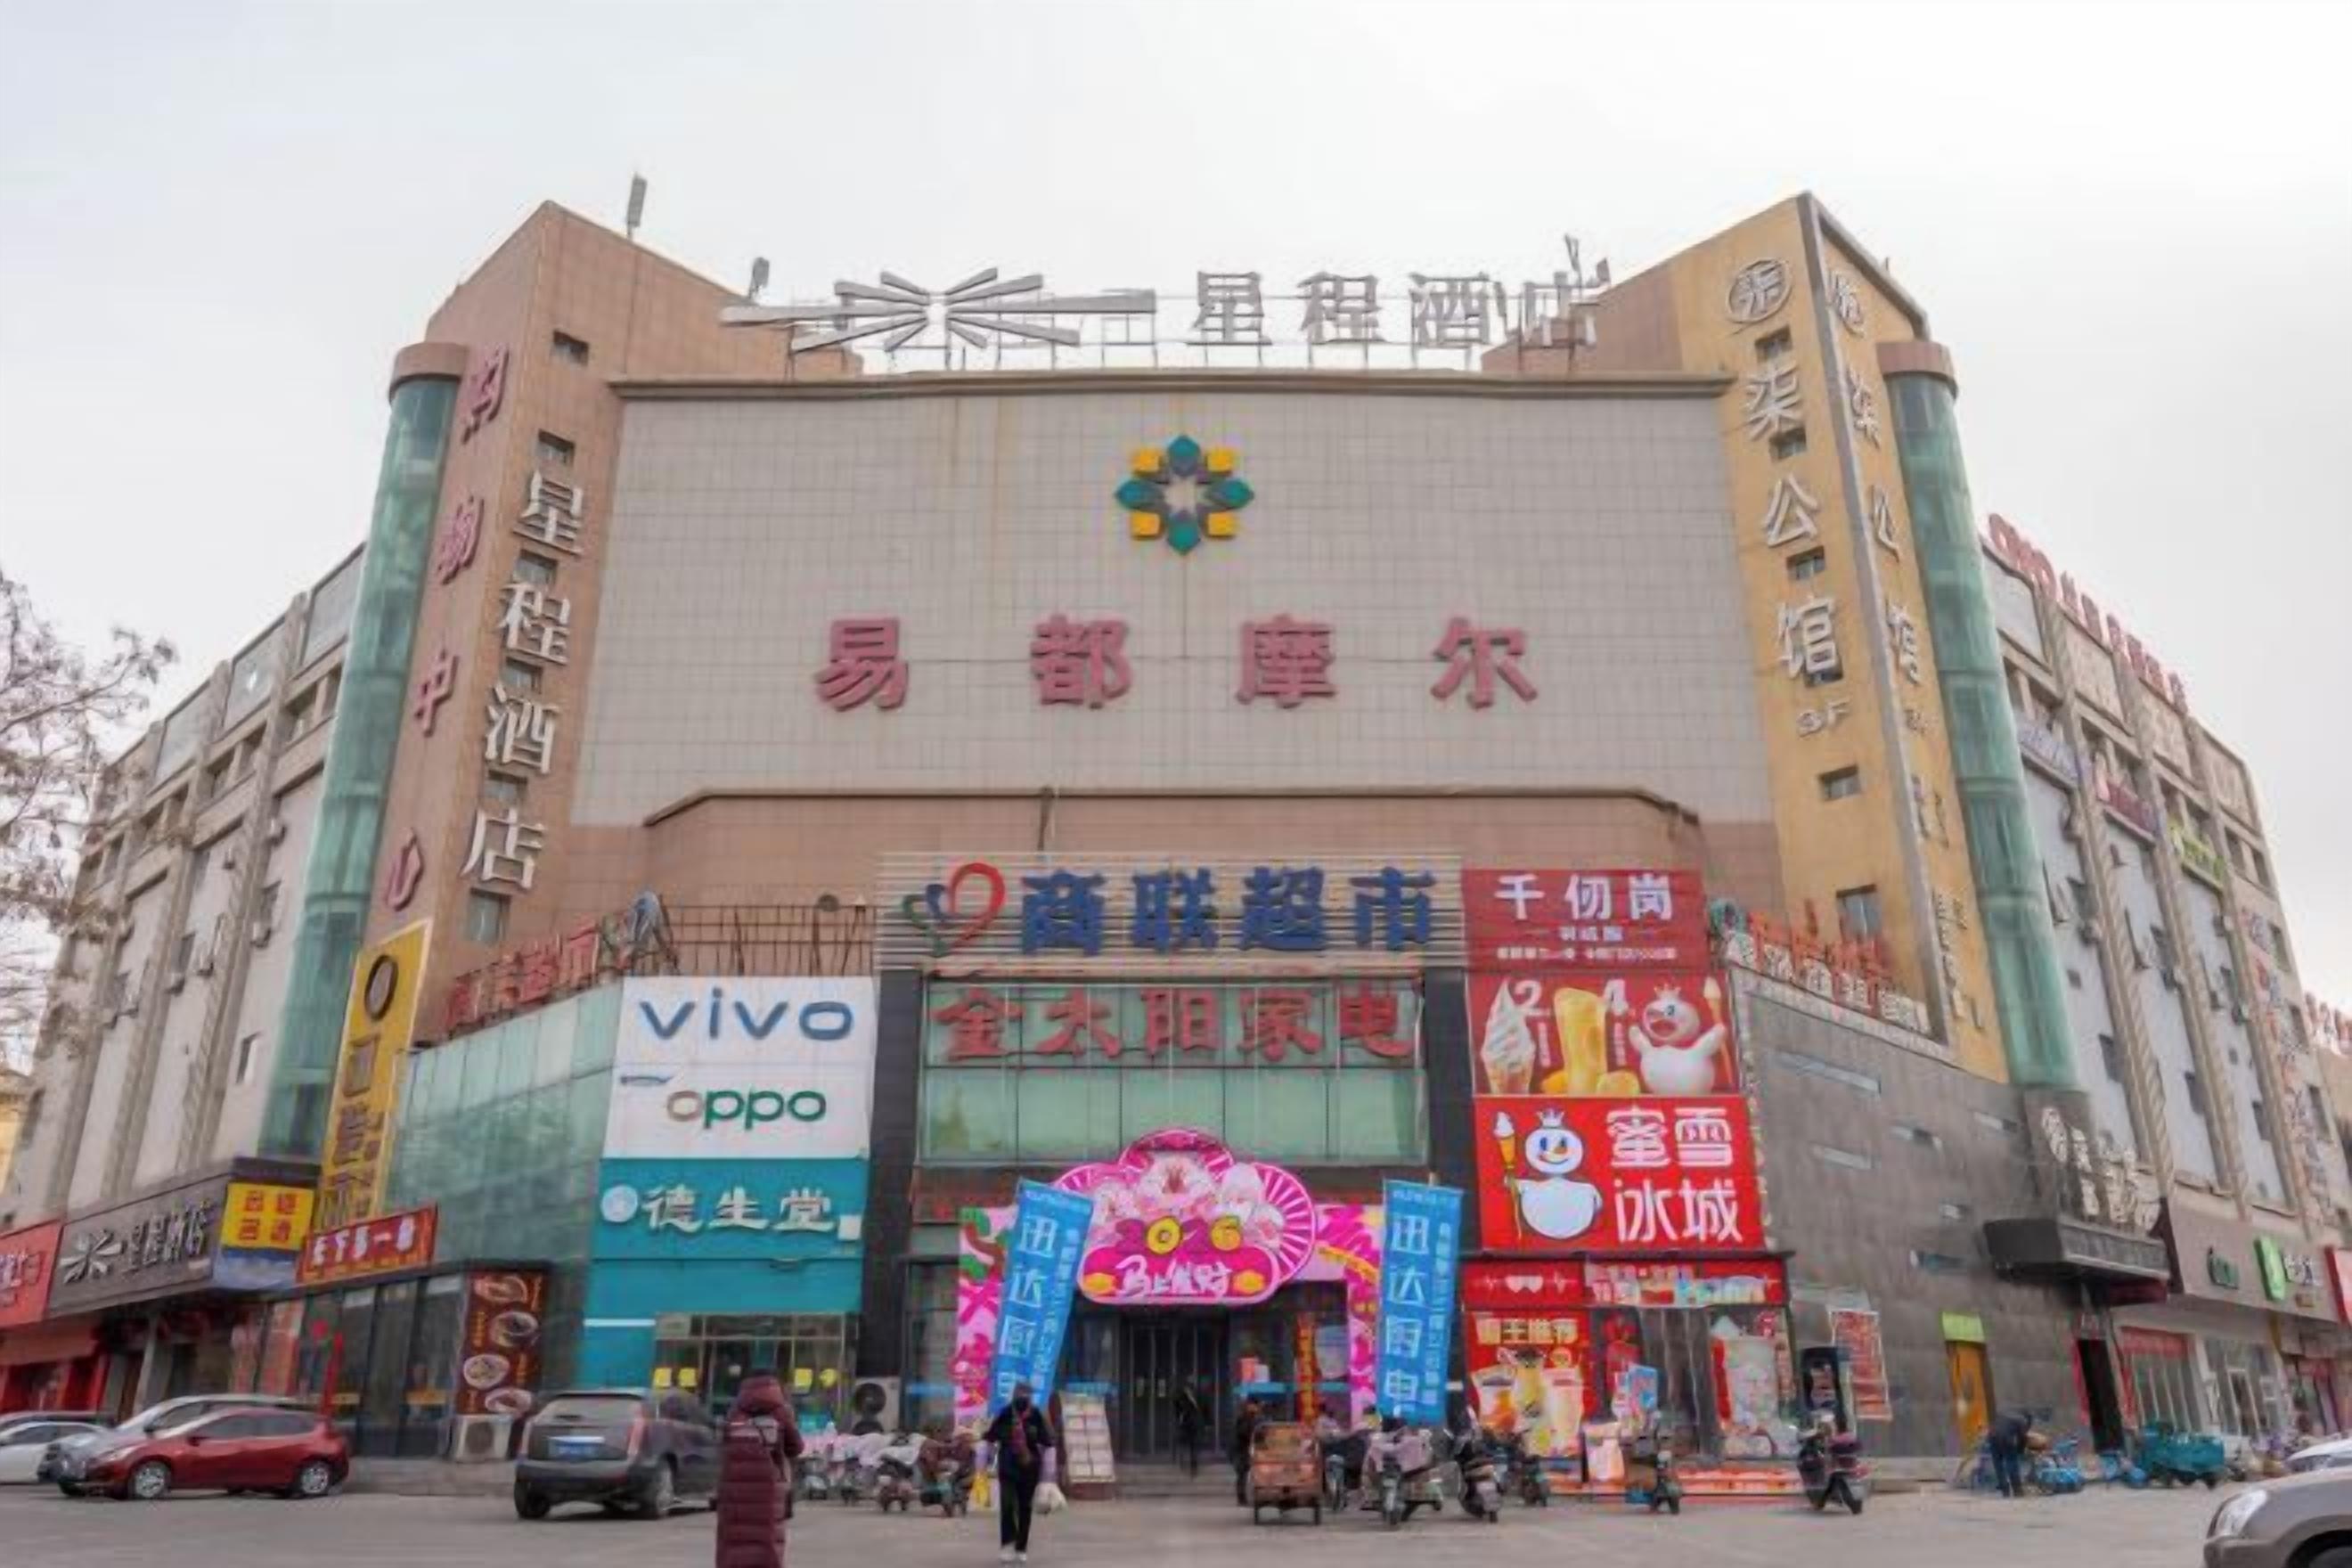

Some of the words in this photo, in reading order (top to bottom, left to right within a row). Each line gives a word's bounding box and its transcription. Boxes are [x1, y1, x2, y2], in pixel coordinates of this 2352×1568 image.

[461, 470, 585, 891] 星程酒店
[815, 615, 1539, 710] 易都摩尔
[1022, 866, 1436, 956] 商联超市
[640, 987, 853, 1041] vivo
[934, 987, 1413, 1060] 金太阳家电
[666, 1089, 827, 1128] oppo
[1606, 1107, 1733, 1169] 蜜雪
[641, 1185, 834, 1232] 德生堂
[1613, 1180, 1743, 1243] 冰城
